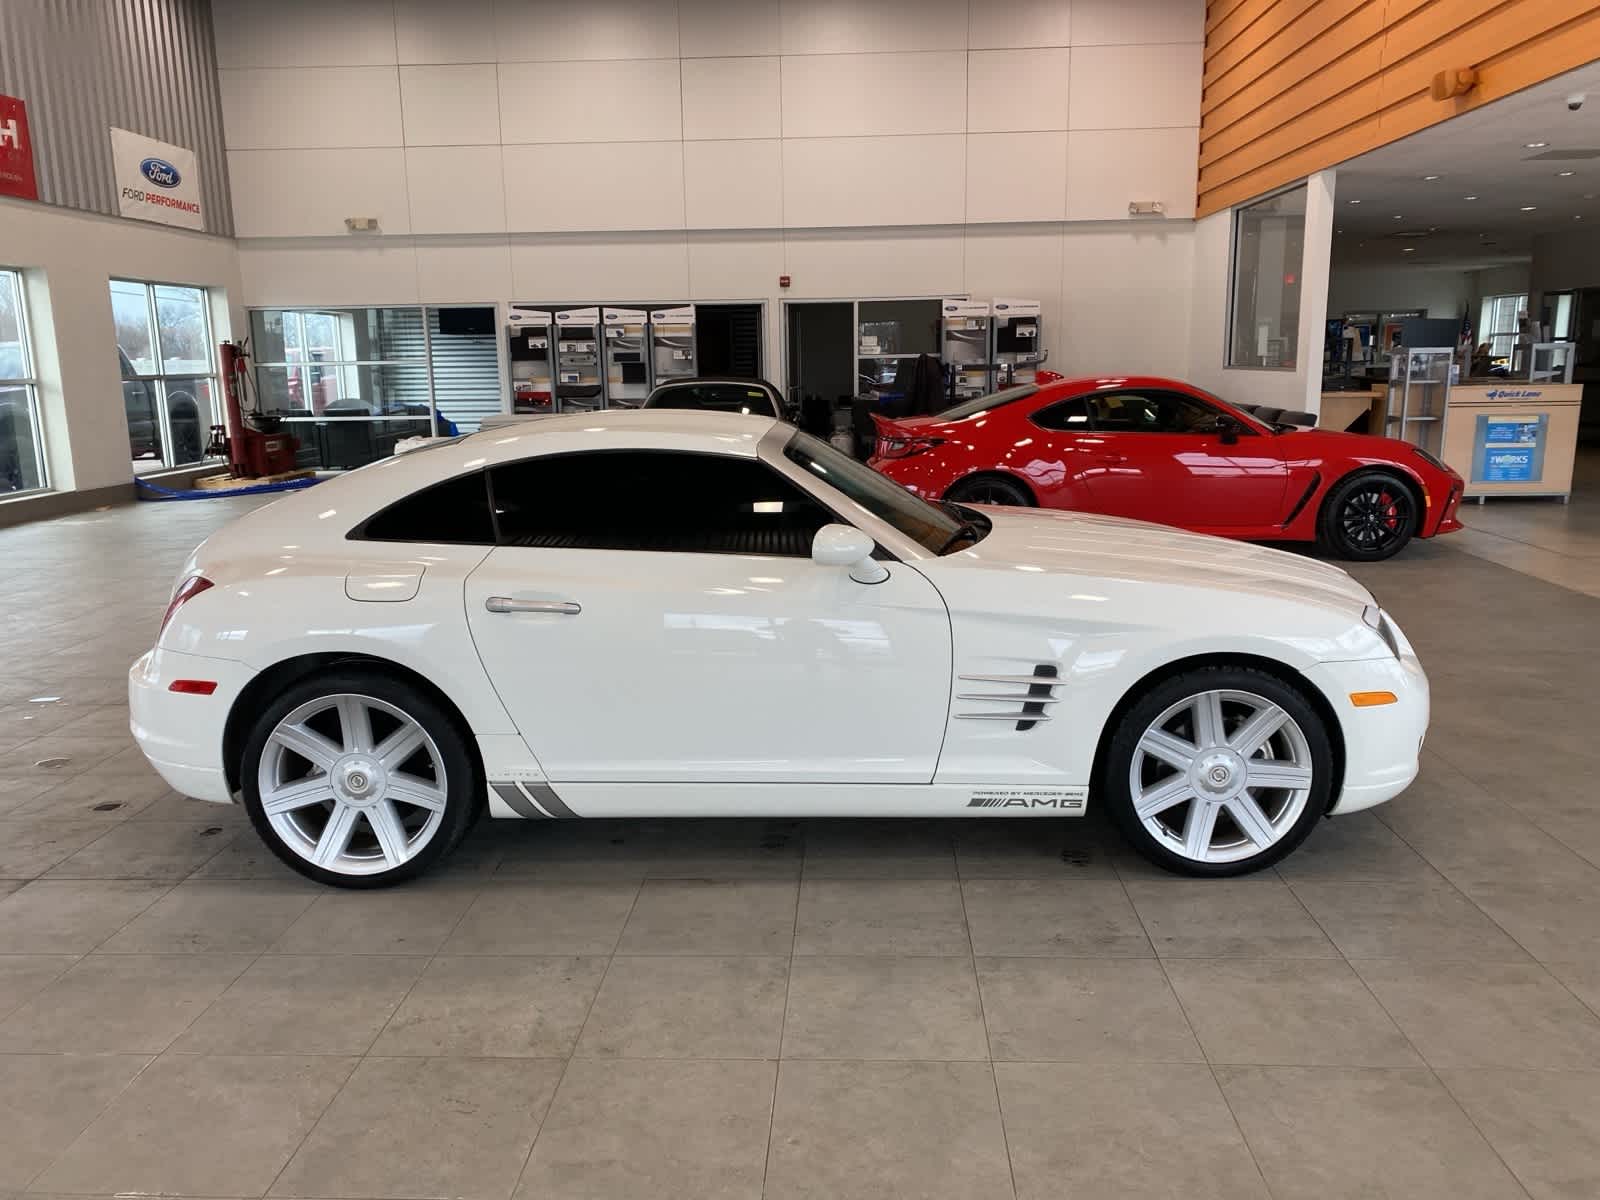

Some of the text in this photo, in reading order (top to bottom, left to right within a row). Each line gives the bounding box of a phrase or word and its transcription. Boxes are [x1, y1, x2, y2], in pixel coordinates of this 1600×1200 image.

[148, 162, 174, 184] Ford
[122, 187, 200, 214] FORD PERFORMANCE
[1002, 798, 1083, 809] AMG
